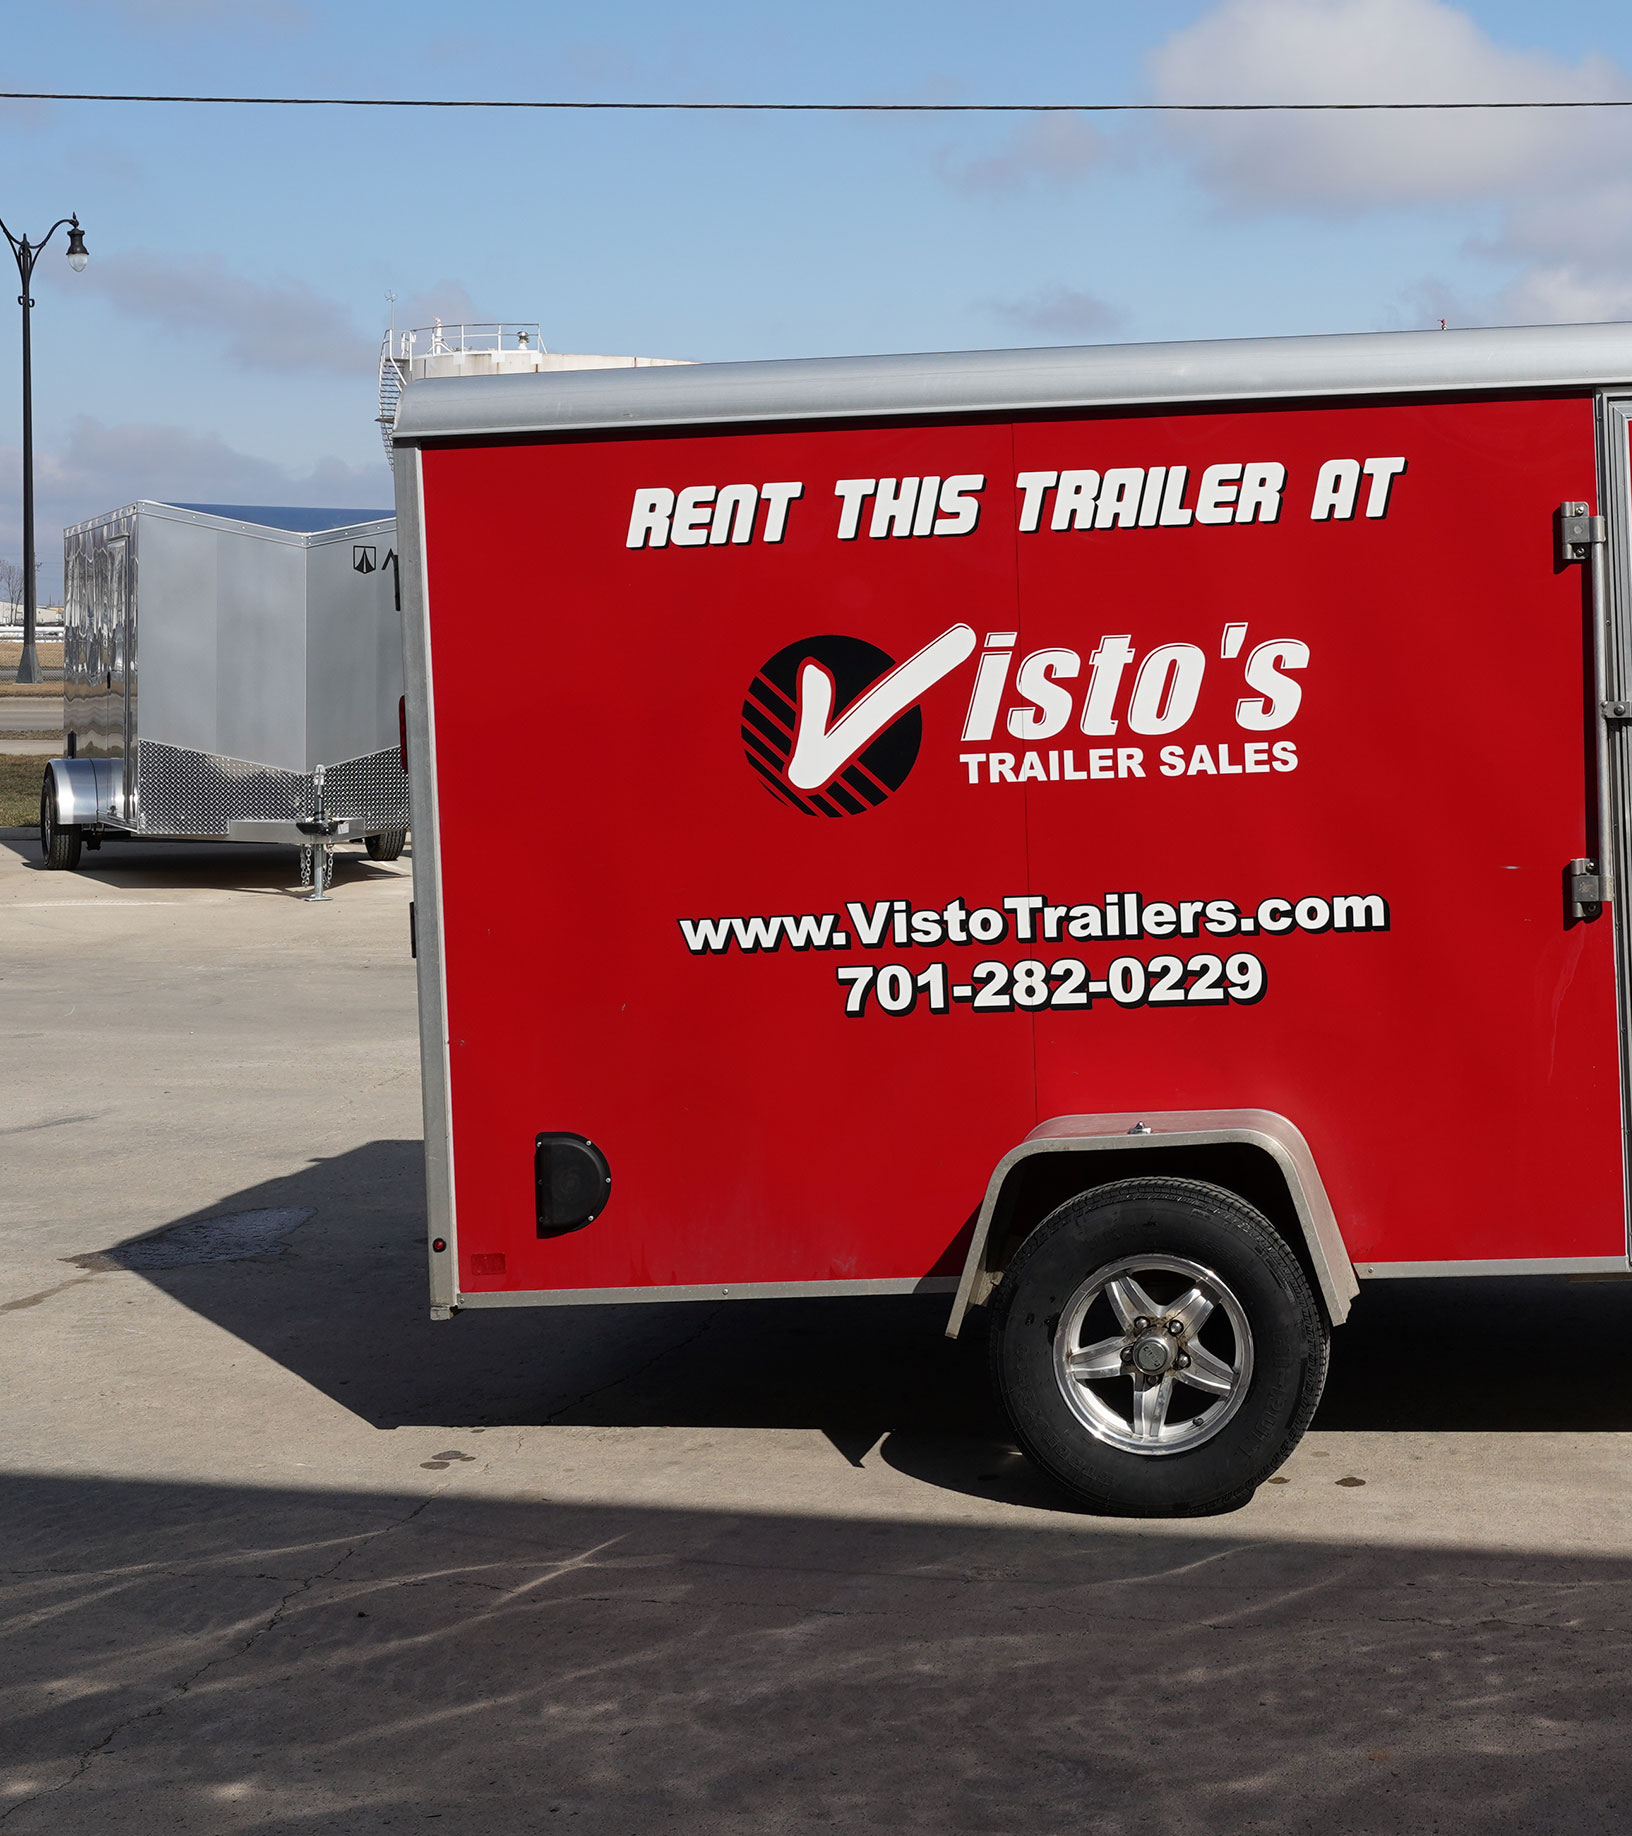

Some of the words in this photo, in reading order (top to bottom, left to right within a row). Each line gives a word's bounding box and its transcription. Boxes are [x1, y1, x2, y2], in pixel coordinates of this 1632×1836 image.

[626, 481, 803, 551] RENT
[835, 474, 987, 540] THIS
[1016, 461, 1286, 533] TRAILER
[1310, 457, 1408, 522] AT
[959, 748, 1145, 784] TRAILER
[1159, 741, 1300, 776] SALES
[679, 892, 1389, 955] www.VistoTrailers.com
[837, 952, 1266, 1017] 701-282-0229
